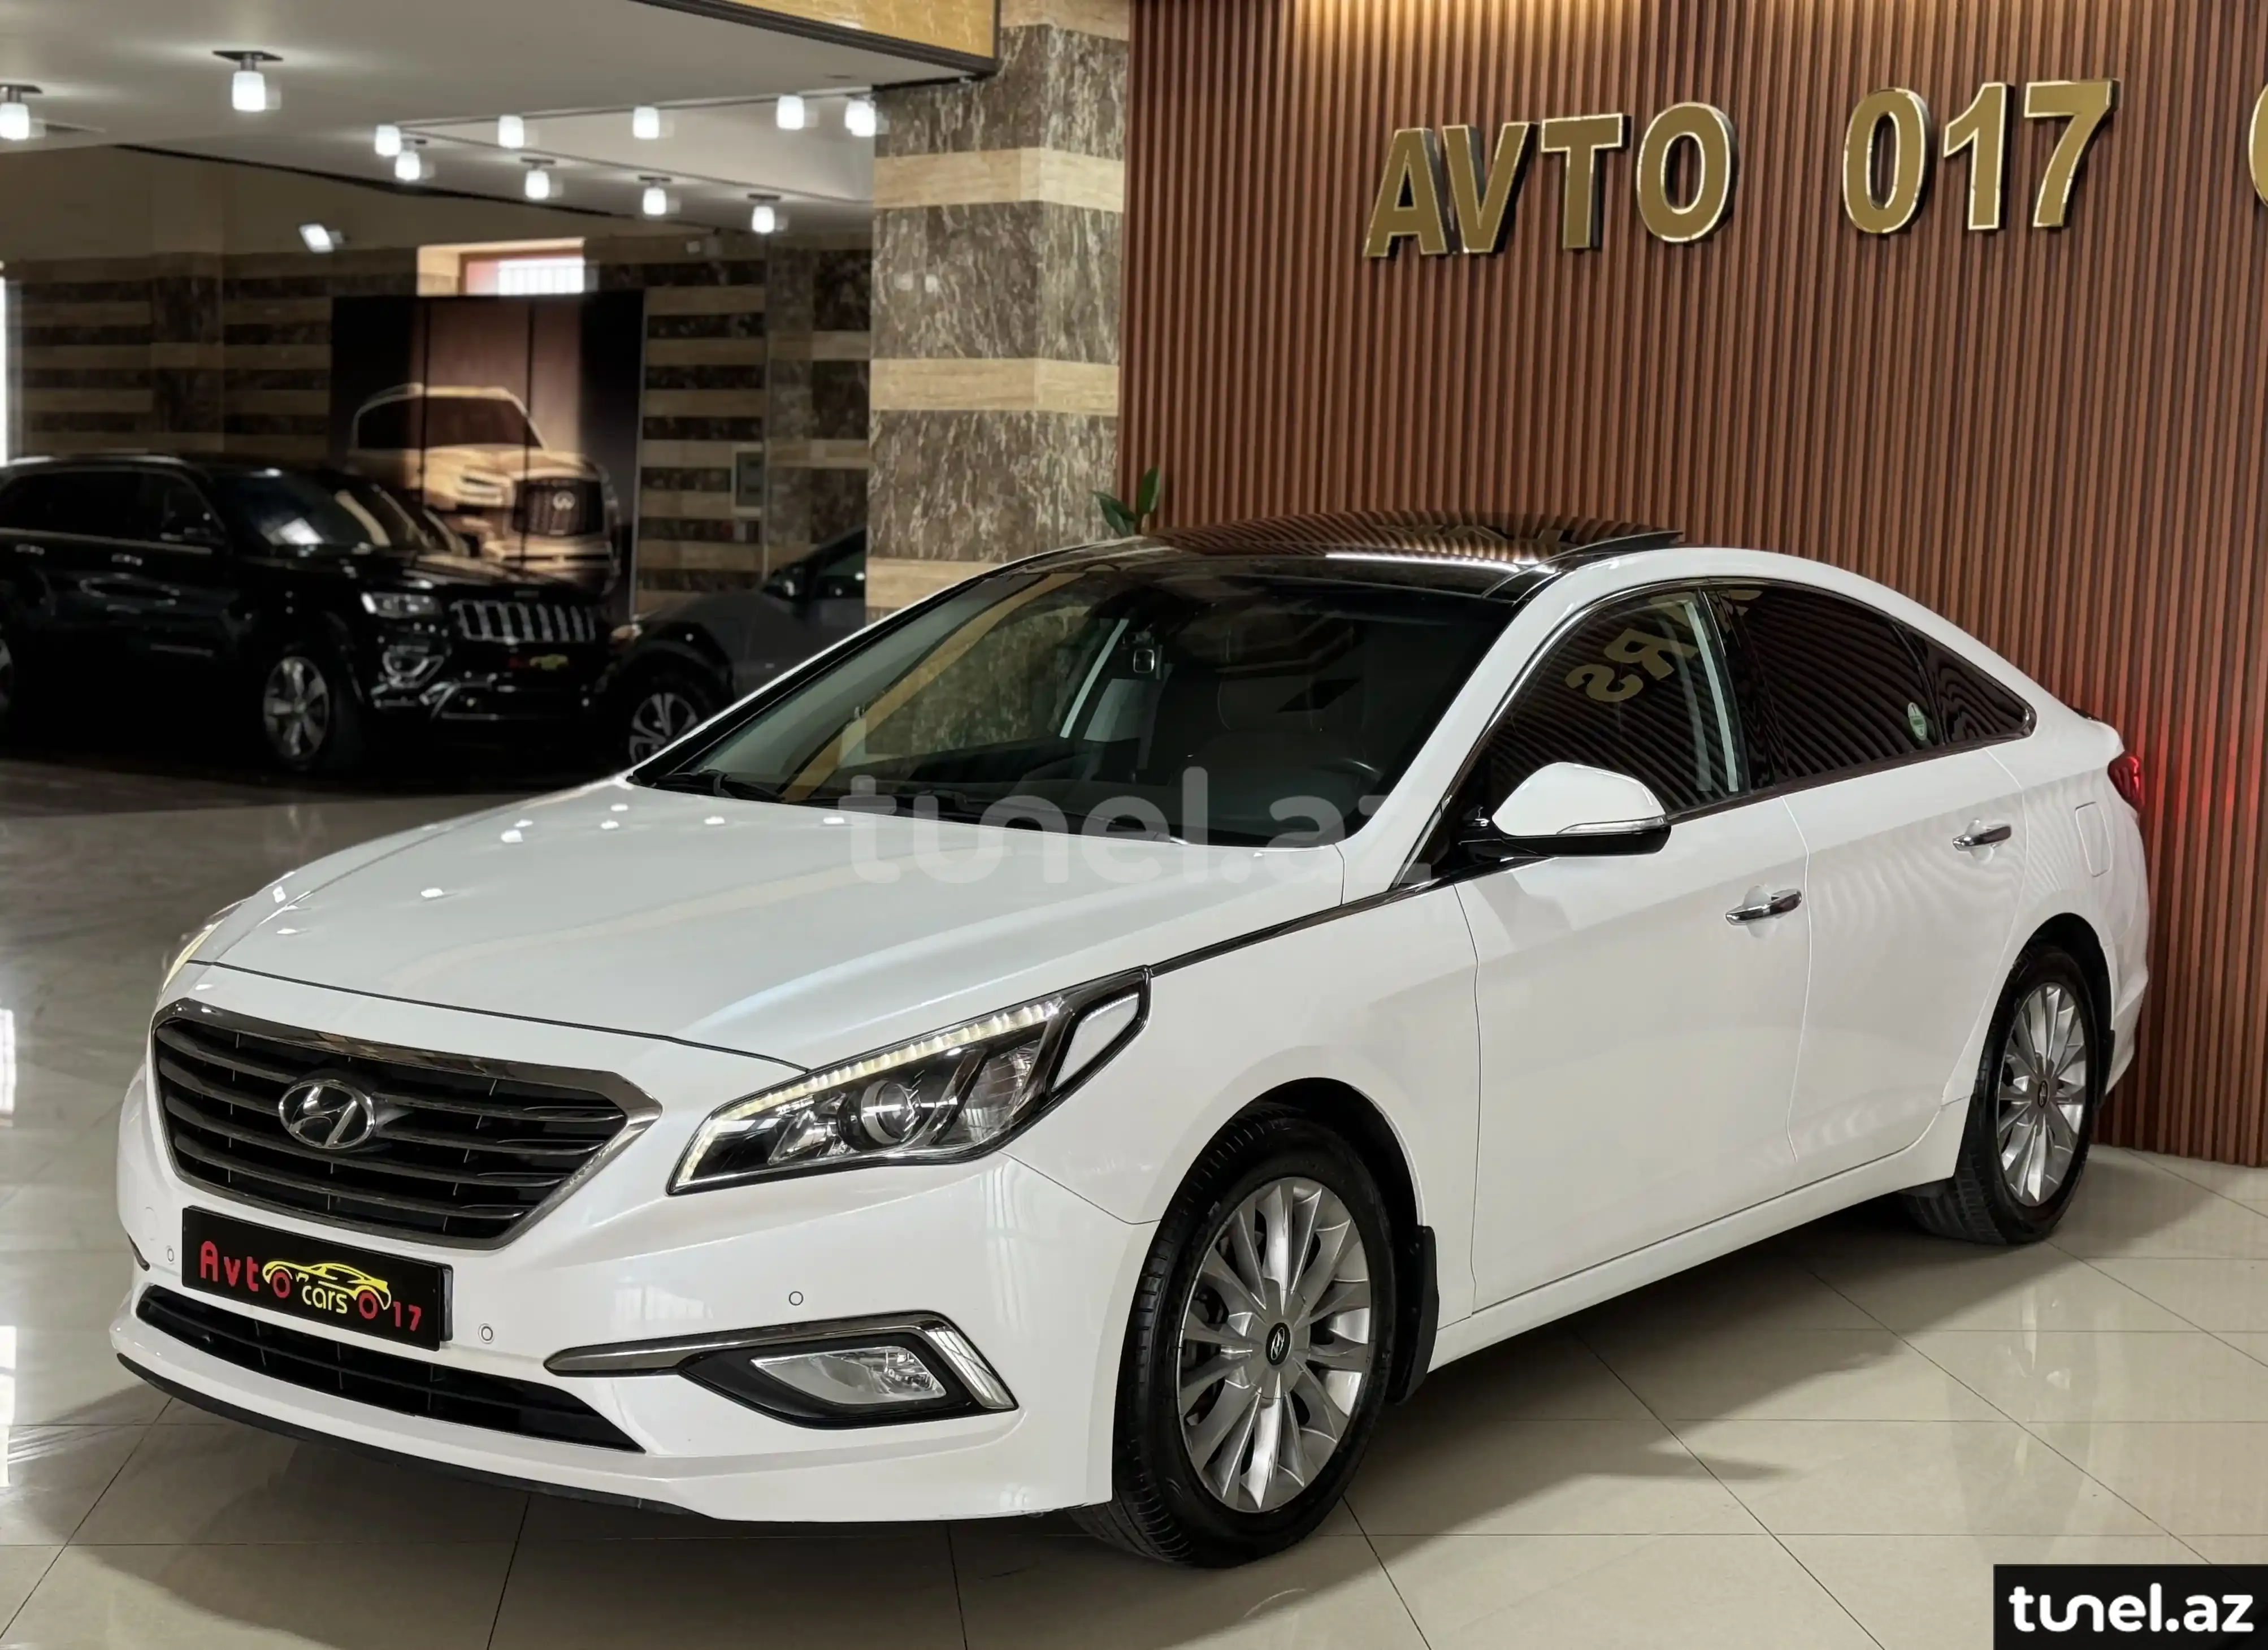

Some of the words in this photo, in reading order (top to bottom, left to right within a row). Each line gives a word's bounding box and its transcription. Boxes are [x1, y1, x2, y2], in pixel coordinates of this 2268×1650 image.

[1363, 102, 1736, 258] AVTO
[1842, 77, 2121, 235] 017
[302, 1285, 348, 1314] cars
